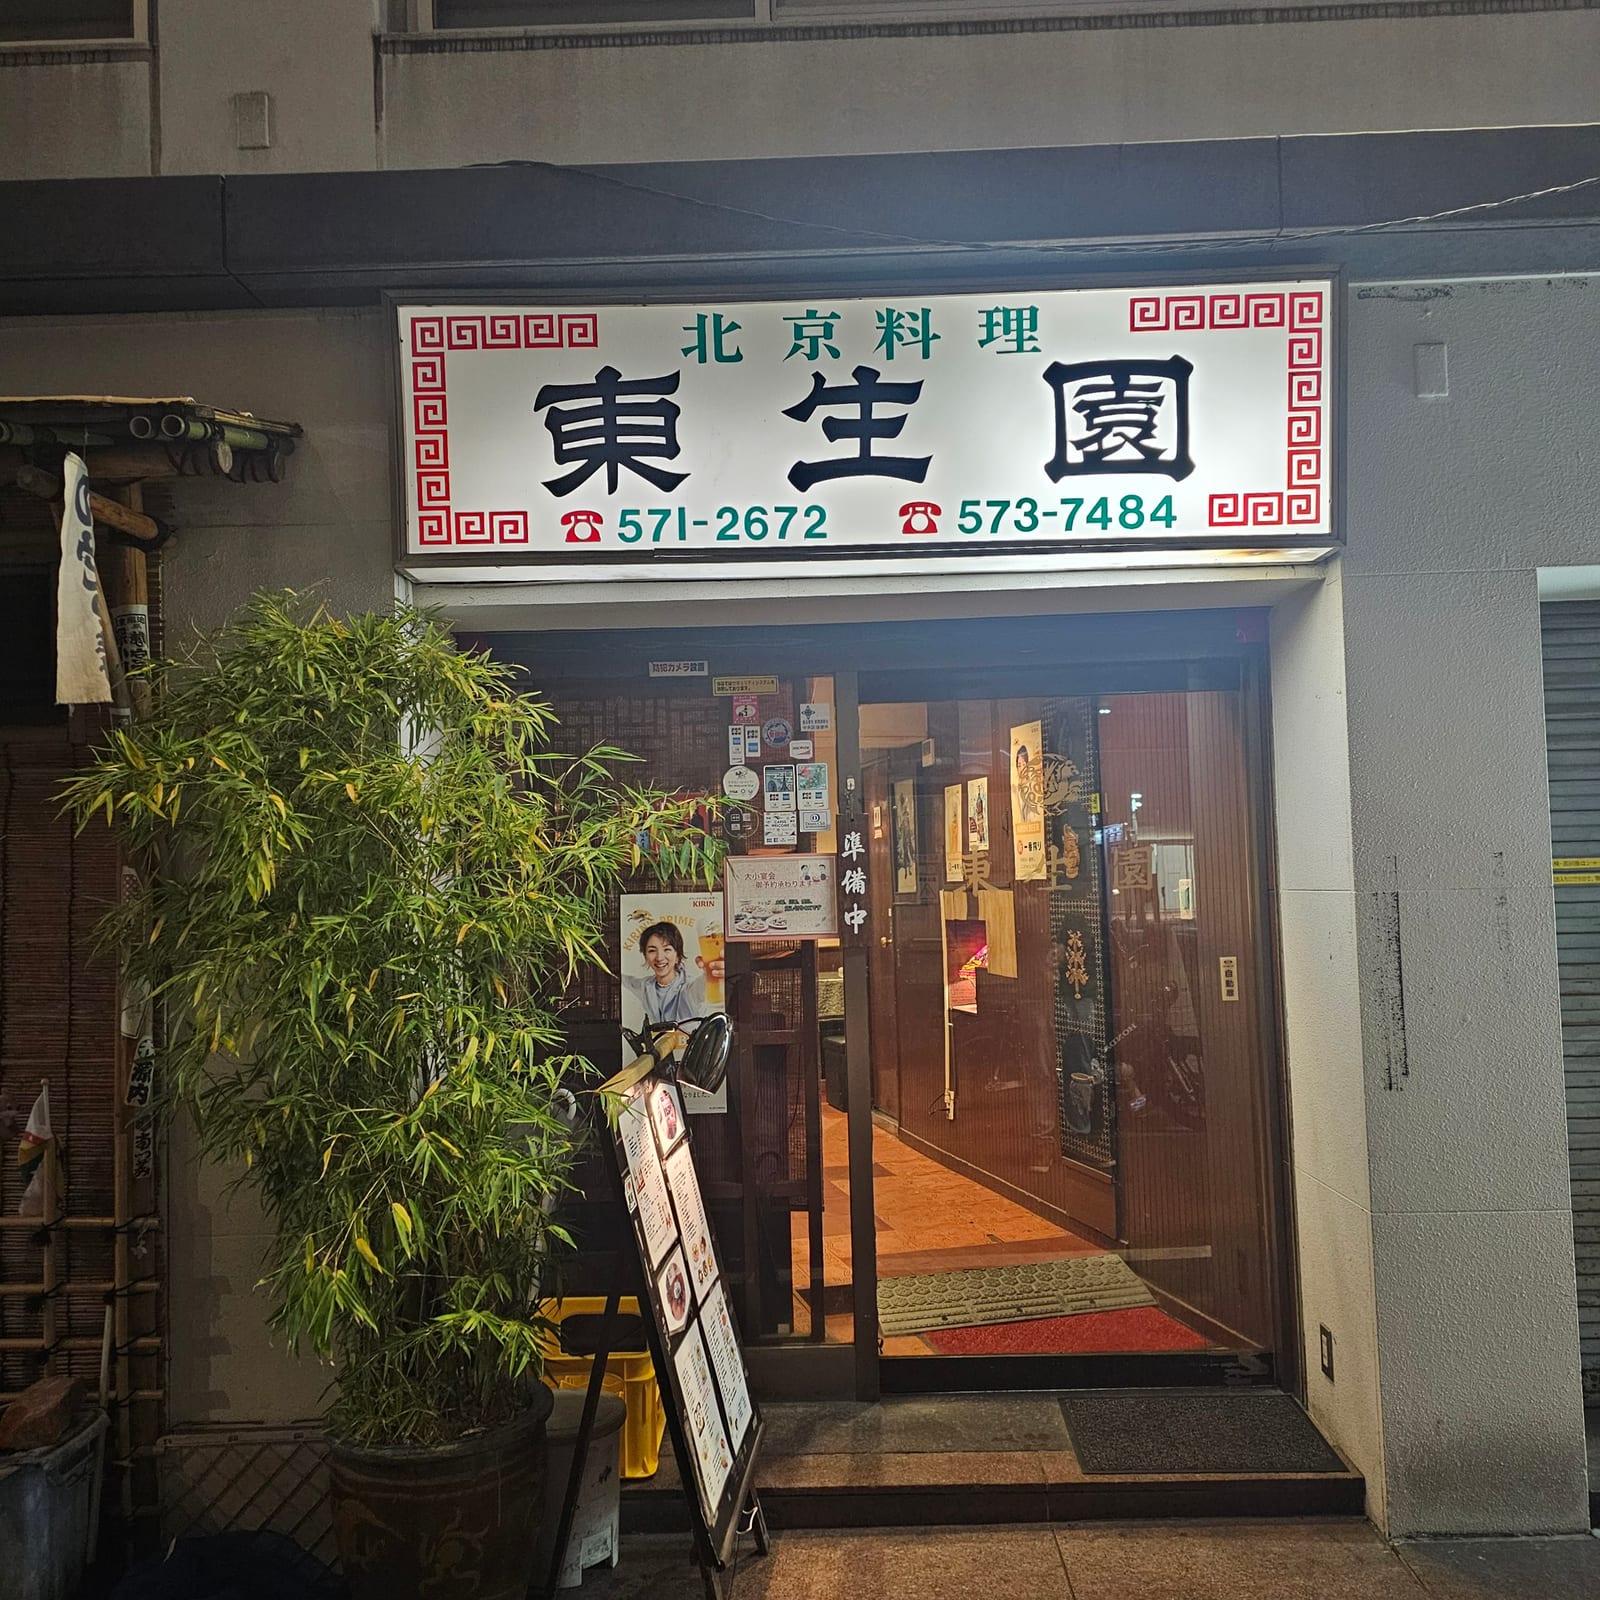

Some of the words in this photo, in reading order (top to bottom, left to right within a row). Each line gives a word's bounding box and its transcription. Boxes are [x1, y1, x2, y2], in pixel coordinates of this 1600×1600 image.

[681, 304, 1042, 364] 北京料理
[533, 354, 1197, 498] 東生園
[617, 504, 829, 544] 571-2672
[957, 494, 1178, 534] 573-7484
[692, 900, 715, 908] KIRIN
[841, 831, 866, 935] 準備中
